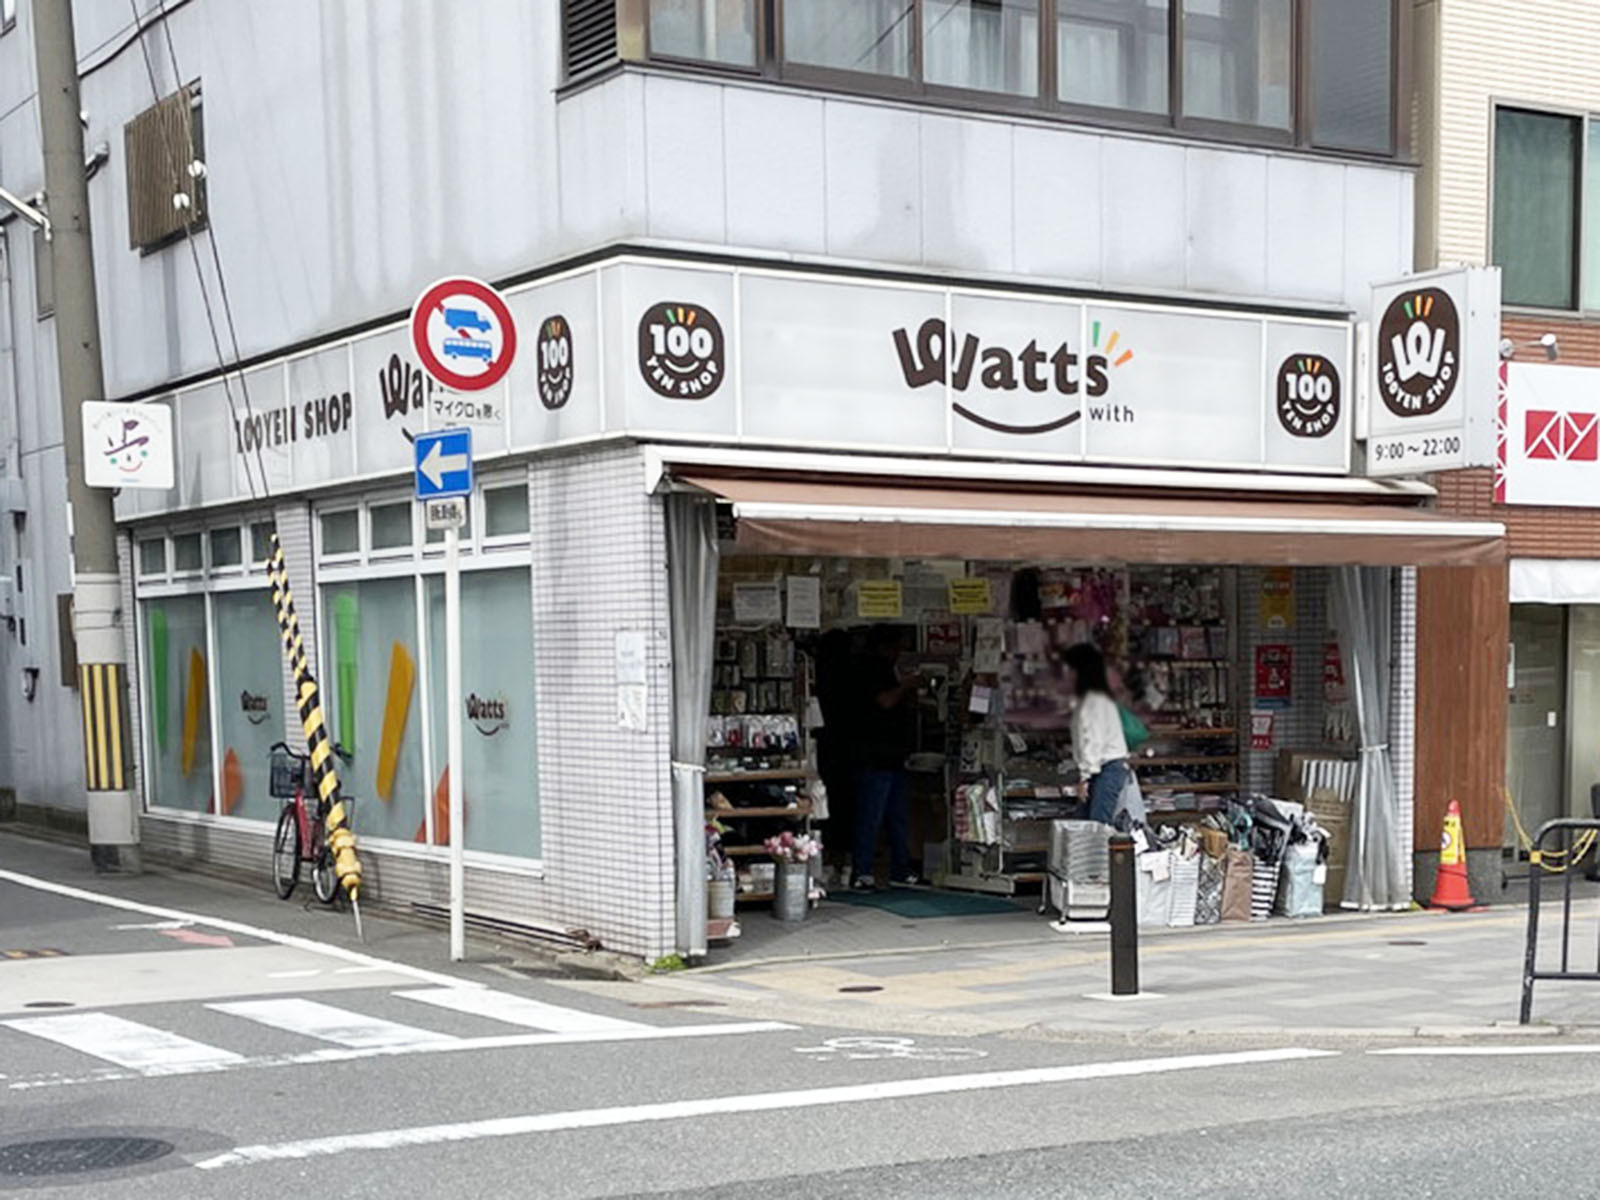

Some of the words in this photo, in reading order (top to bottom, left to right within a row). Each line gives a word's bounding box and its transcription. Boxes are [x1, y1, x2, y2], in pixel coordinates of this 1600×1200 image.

[540, 337, 569, 371] 100
[649, 323, 713, 359] 100
[892, 317, 1110, 397] Watts
[646, 355, 675, 391] YEN
[679, 359, 718, 395] SHOP
[1285, 372, 1333, 402] 100
[1426, 350, 1456, 405] SHOP
[304, 391, 352, 440] SHOP
[1089, 403, 1135, 423] with
[1281, 400, 1303, 430] YEN
[1305, 403, 1335, 434] SHOP
[464, 692, 504, 720] Watts
